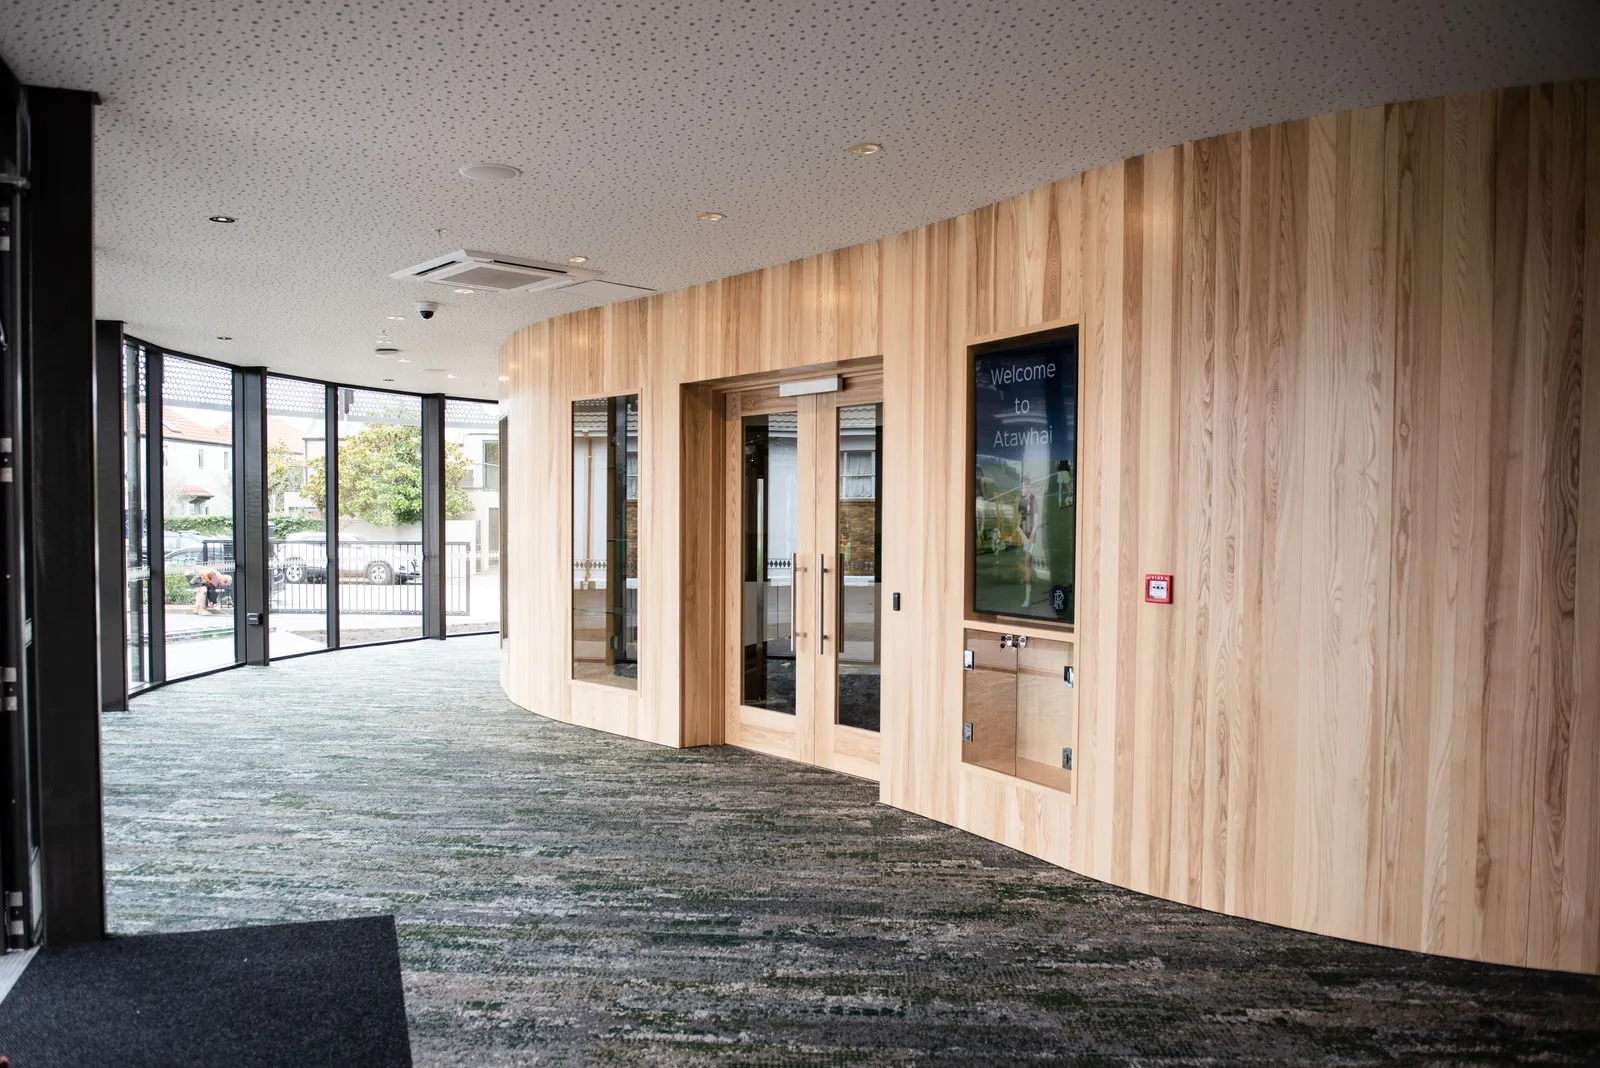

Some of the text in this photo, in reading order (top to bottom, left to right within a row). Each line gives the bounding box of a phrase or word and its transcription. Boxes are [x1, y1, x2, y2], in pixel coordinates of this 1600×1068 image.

[991, 363, 1056, 386] Welcome
[1015, 398, 1030, 414] to
[993, 425, 1053, 447] Atawhai
